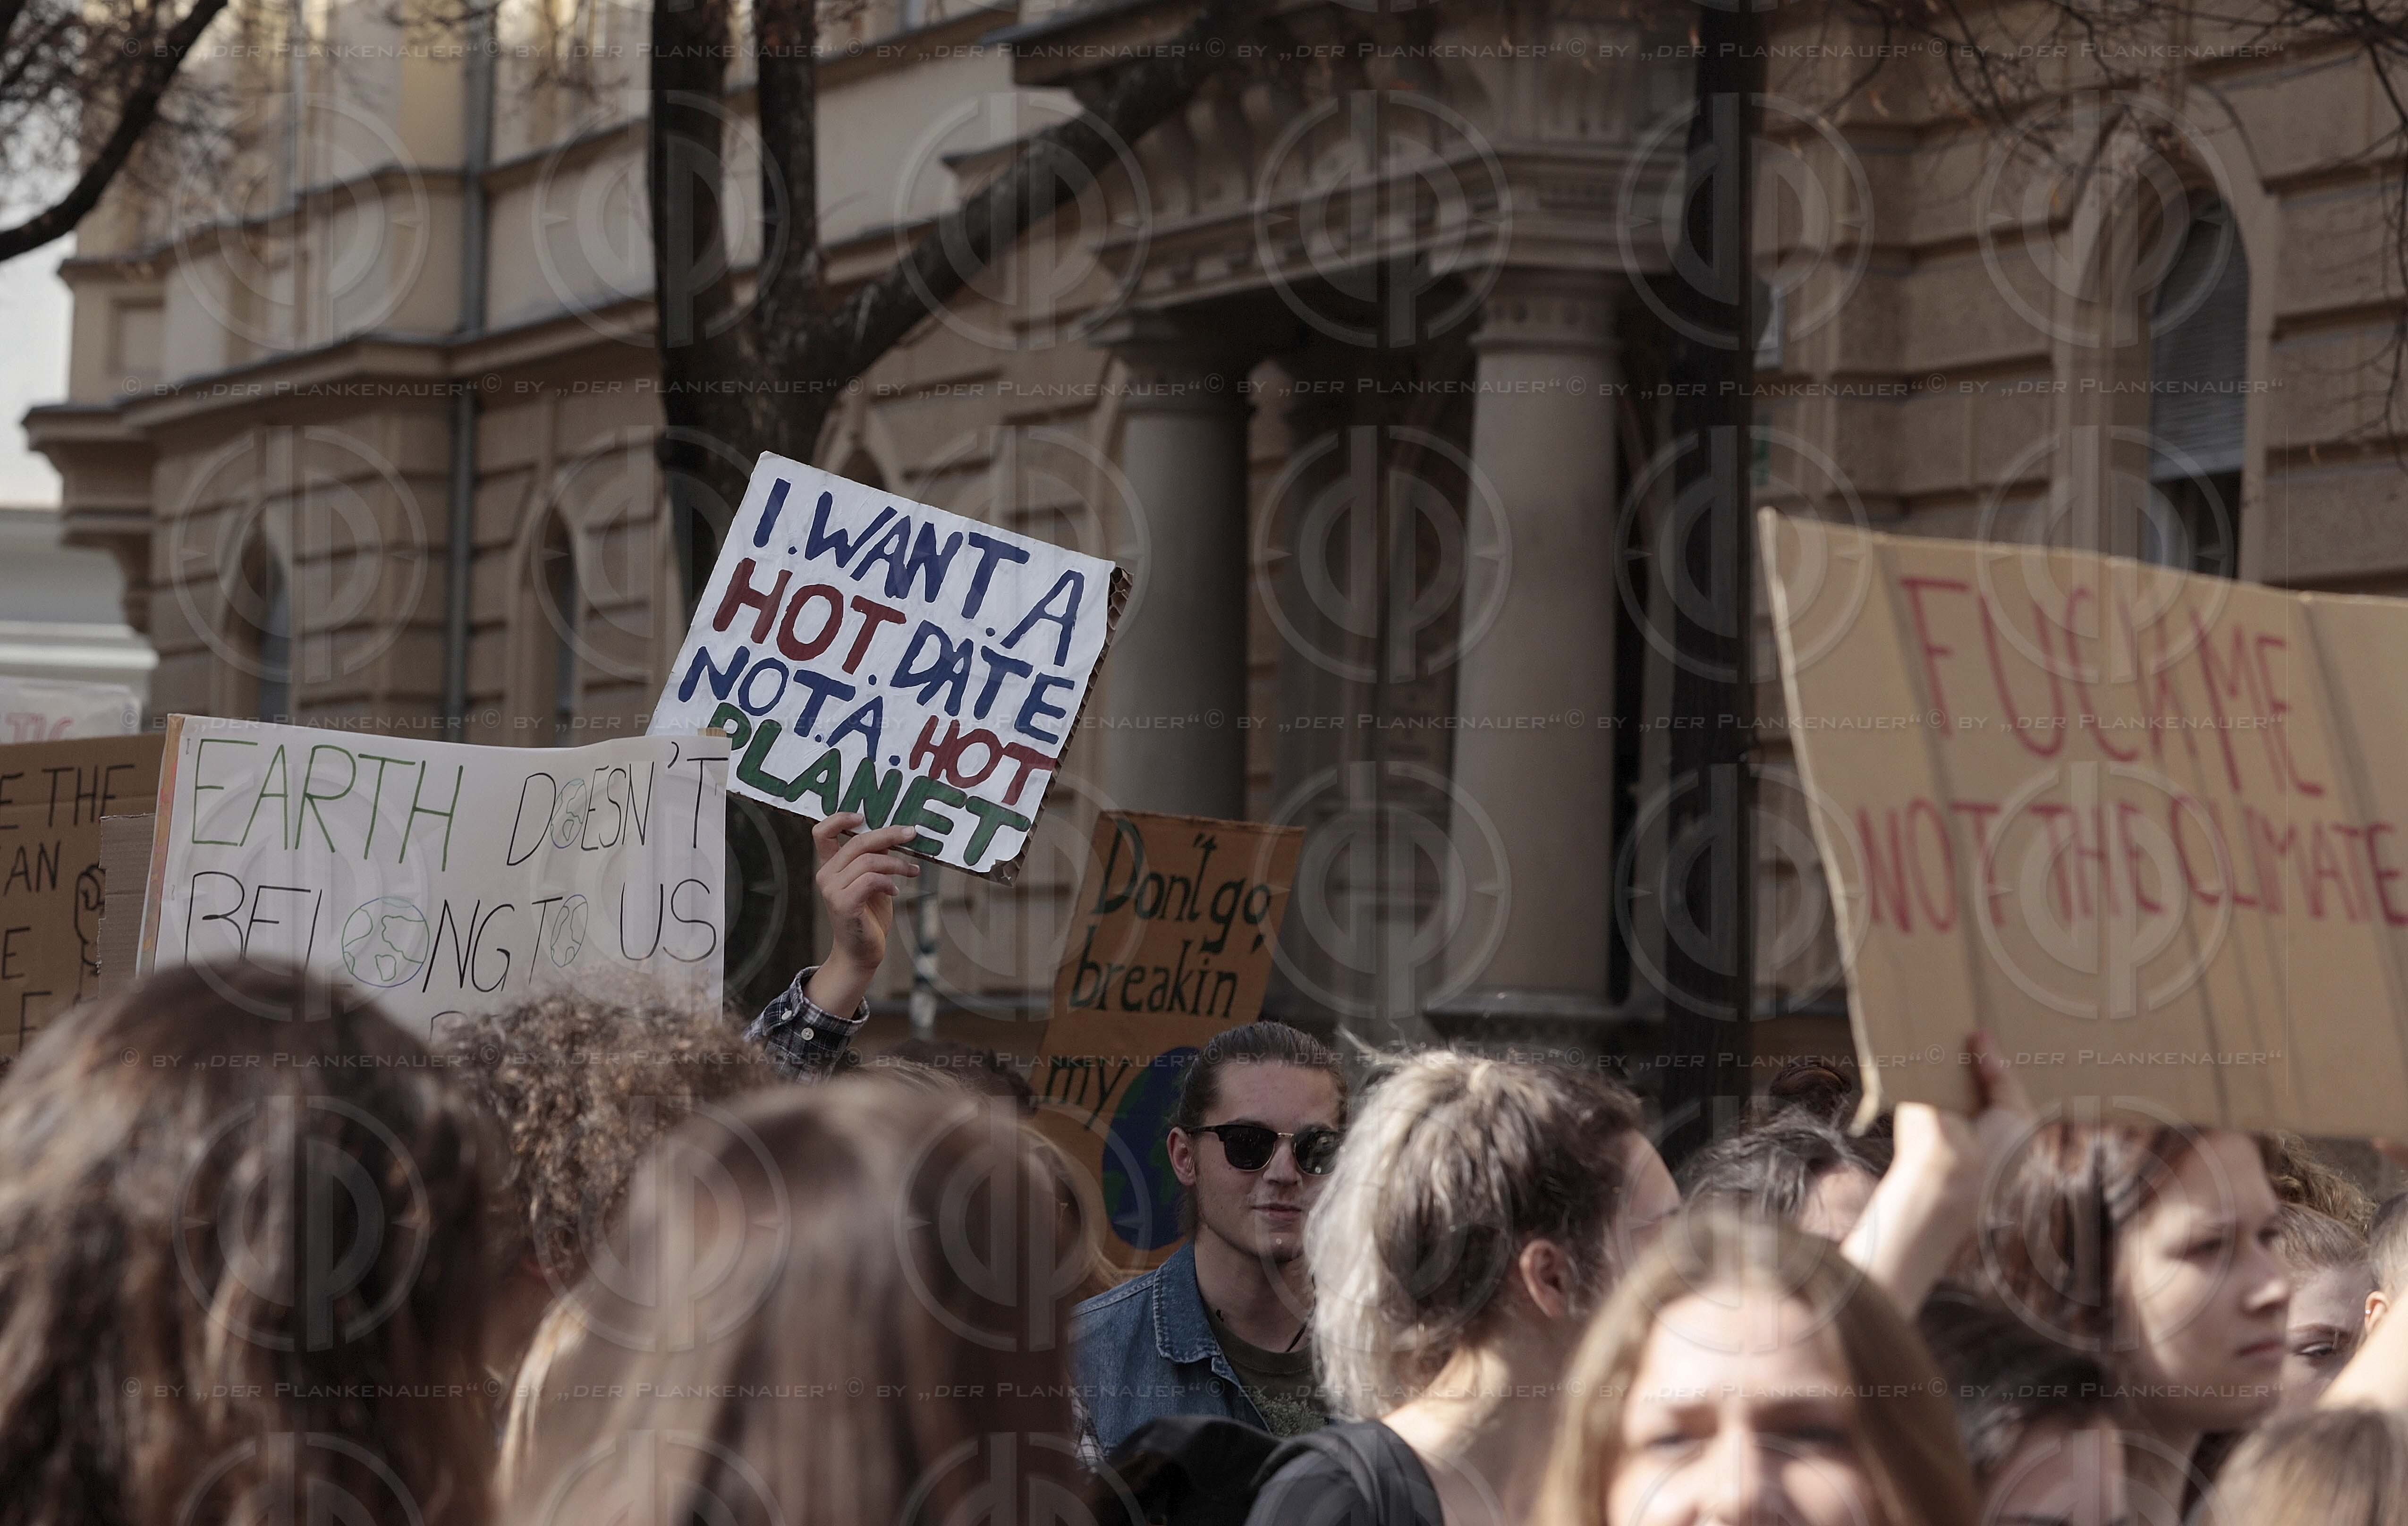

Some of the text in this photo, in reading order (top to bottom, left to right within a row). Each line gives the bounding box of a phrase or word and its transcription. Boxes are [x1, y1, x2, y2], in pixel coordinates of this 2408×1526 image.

[890, 619, 1076, 745] DATE
[1898, 577, 2326, 798] FUCK ME
[41, 764, 136, 828] THE
[191, 738, 463, 873] EARTH
[707, 702, 1031, 867] PLANET
[909, 714, 1057, 806] HOT
[1857, 793, 2408, 935] NOT THE CLIMATE
[619, 878, 717, 963] US
[1068, 924, 1238, 1019] breakin
[1044, 1056, 1128, 1130] my
